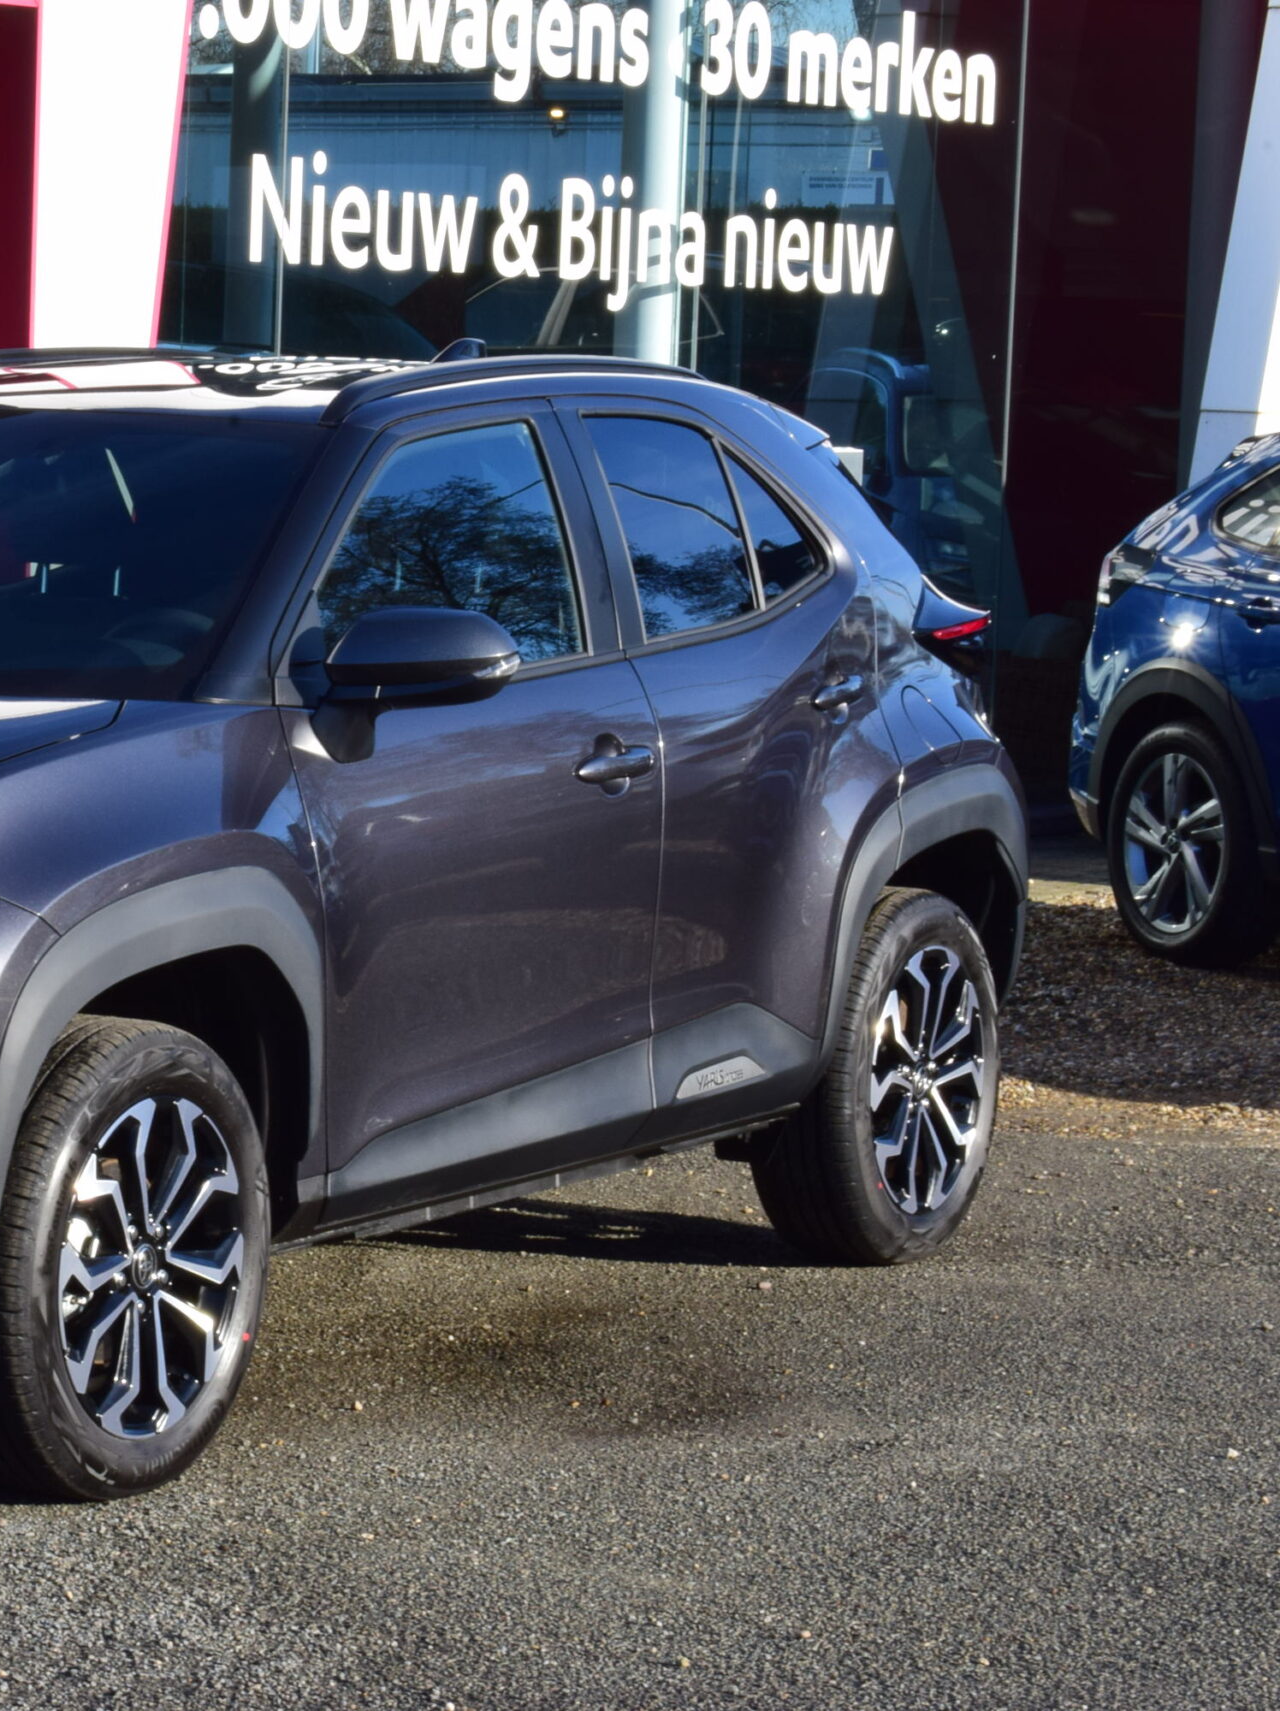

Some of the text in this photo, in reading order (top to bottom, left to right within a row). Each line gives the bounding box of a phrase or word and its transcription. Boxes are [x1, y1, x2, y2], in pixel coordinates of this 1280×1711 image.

[387, 0, 650, 102] wagens
[699, 0, 772, 99] 30
[786, 10, 997, 125] merken
[248, 151, 896, 311] Nieuw & Bijna nieuw
